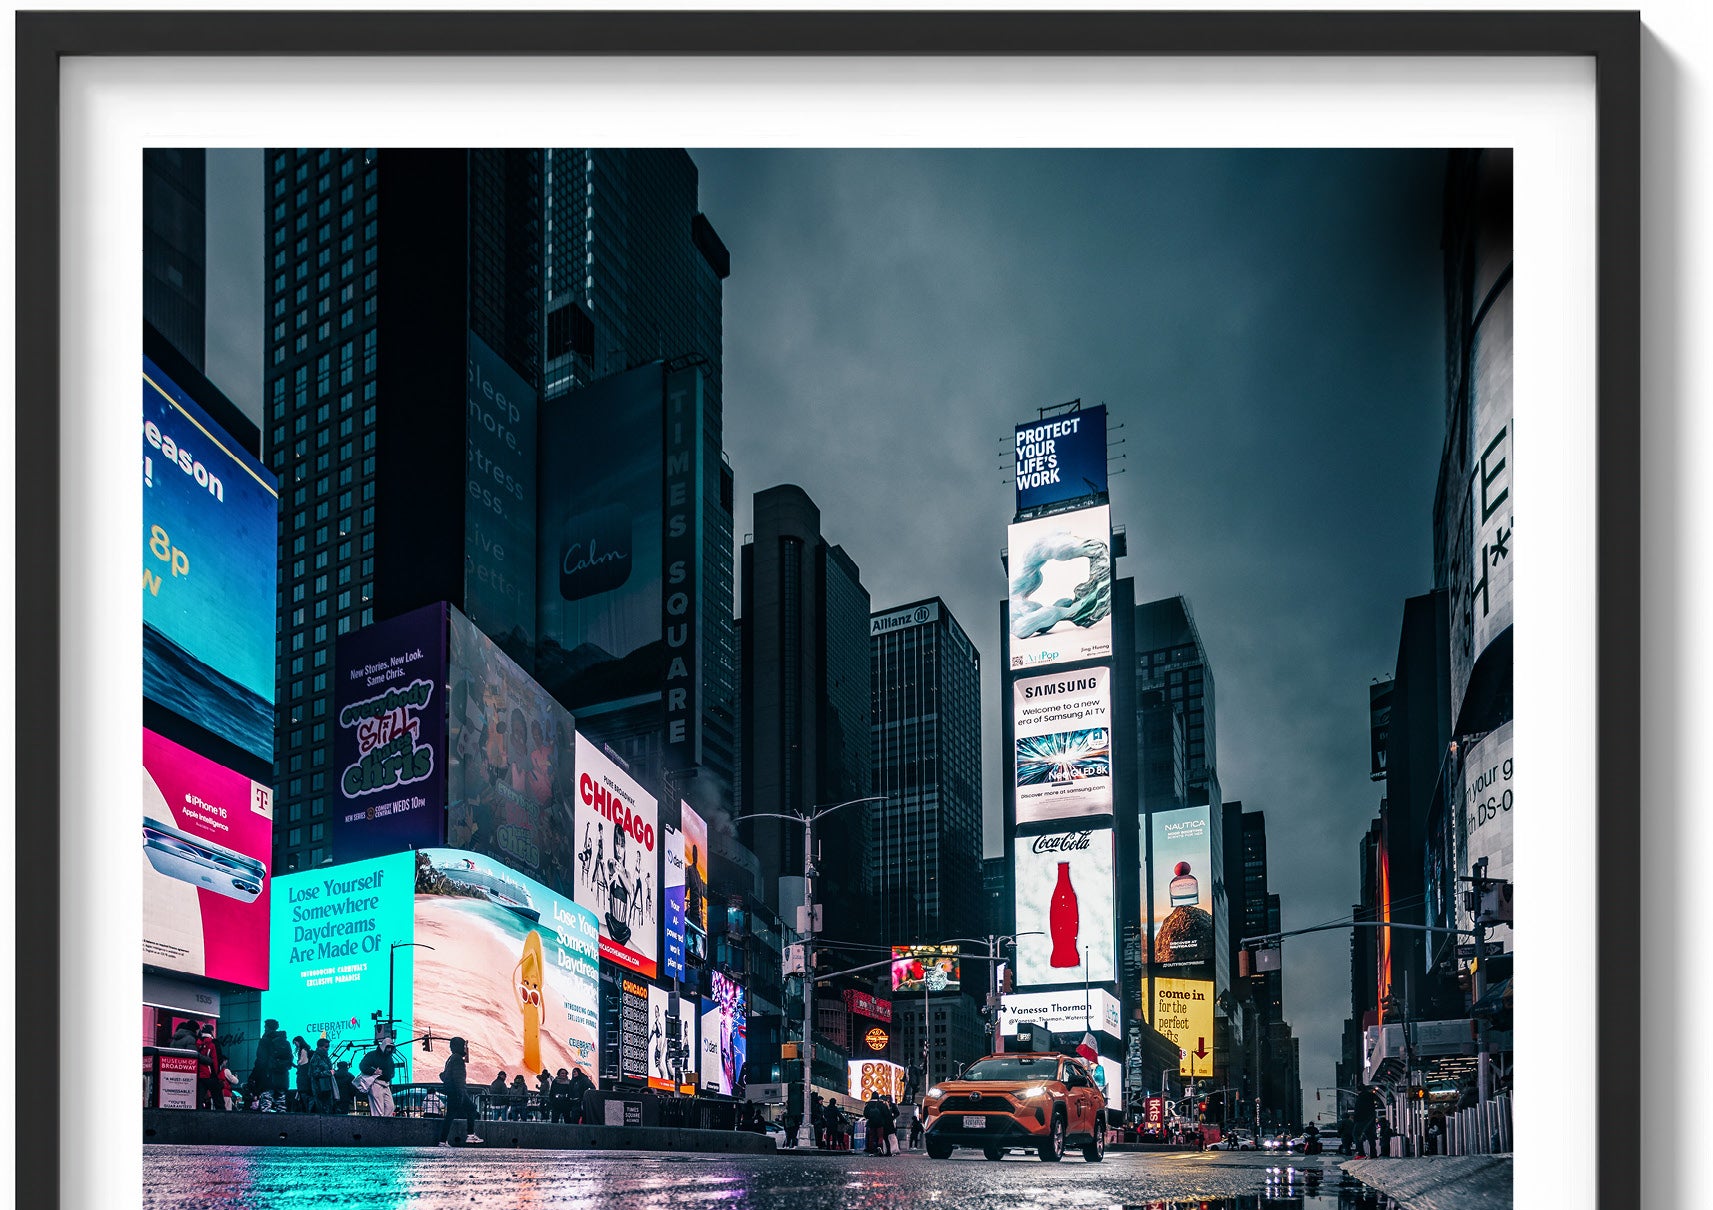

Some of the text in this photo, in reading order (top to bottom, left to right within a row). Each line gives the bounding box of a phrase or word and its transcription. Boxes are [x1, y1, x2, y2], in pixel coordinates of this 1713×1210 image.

[1016, 418, 1080, 447] PROTECT
[143, 420, 224, 502] eason
[1016, 440, 1056, 460] YOUR
[667, 390, 688, 538] TIMES
[1016, 454, 1057, 476] LIFE'S
[1016, 467, 1060, 491] WORK
[469, 480, 509, 520] ess.
[149, 524, 190, 578] 8p
[563, 538, 628, 576] Calm
[872, 614, 912, 632] Allianz
[667, 560, 688, 744] SQUARE
[350, 648, 424, 681] New Stories. New Look.
[366, 667, 406, 687] Same Chris.
[1025, 677, 1097, 699] SAMSUNG
[341, 680, 432, 726] everybody
[1022, 704, 1062, 716] Welcome
[1063, 702, 1072, 711] to
[1081, 700, 1100, 708] new
[1018, 707, 1106, 726] era of Samsung AI TV
[603, 774, 614, 790] PURE
[1070, 767, 1096, 779] QLED
[1096, 765, 1109, 775] 8K
[1021, 791, 1043, 800] Discover
[1066, 784, 1106, 795] samsung.com
[1472, 765, 1498, 803] your
[192, 794, 228, 819] iPhone 16
[256, 788, 269, 811] T
[392, 798, 410, 814] WEDS
[182, 806, 199, 820] Apple
[198, 812, 230, 832] Intelligence
[579, 772, 655, 852] CHICAGO
[1165, 820, 1206, 831] NAUTICA
[289, 870, 384, 904] Lose Yourself
[292, 896, 379, 923] Somewhere
[553, 900, 577, 929] Lose
[294, 918, 376, 945] Daydreams
[289, 934, 382, 964] Are Made Of
[623, 979, 648, 999] CHICAGO
[1159, 989, 1205, 1001] come in
[1010, 1003, 1093, 1015] Vanessa Thorman
[1158, 999, 1187, 1014] for the
[306, 1018, 361, 1033] CELEBRATION
[1158, 1016, 1190, 1032] perfect
[161, 1063, 197, 1071] BROADWAY
[1149, 1099, 1161, 1122] tkts
